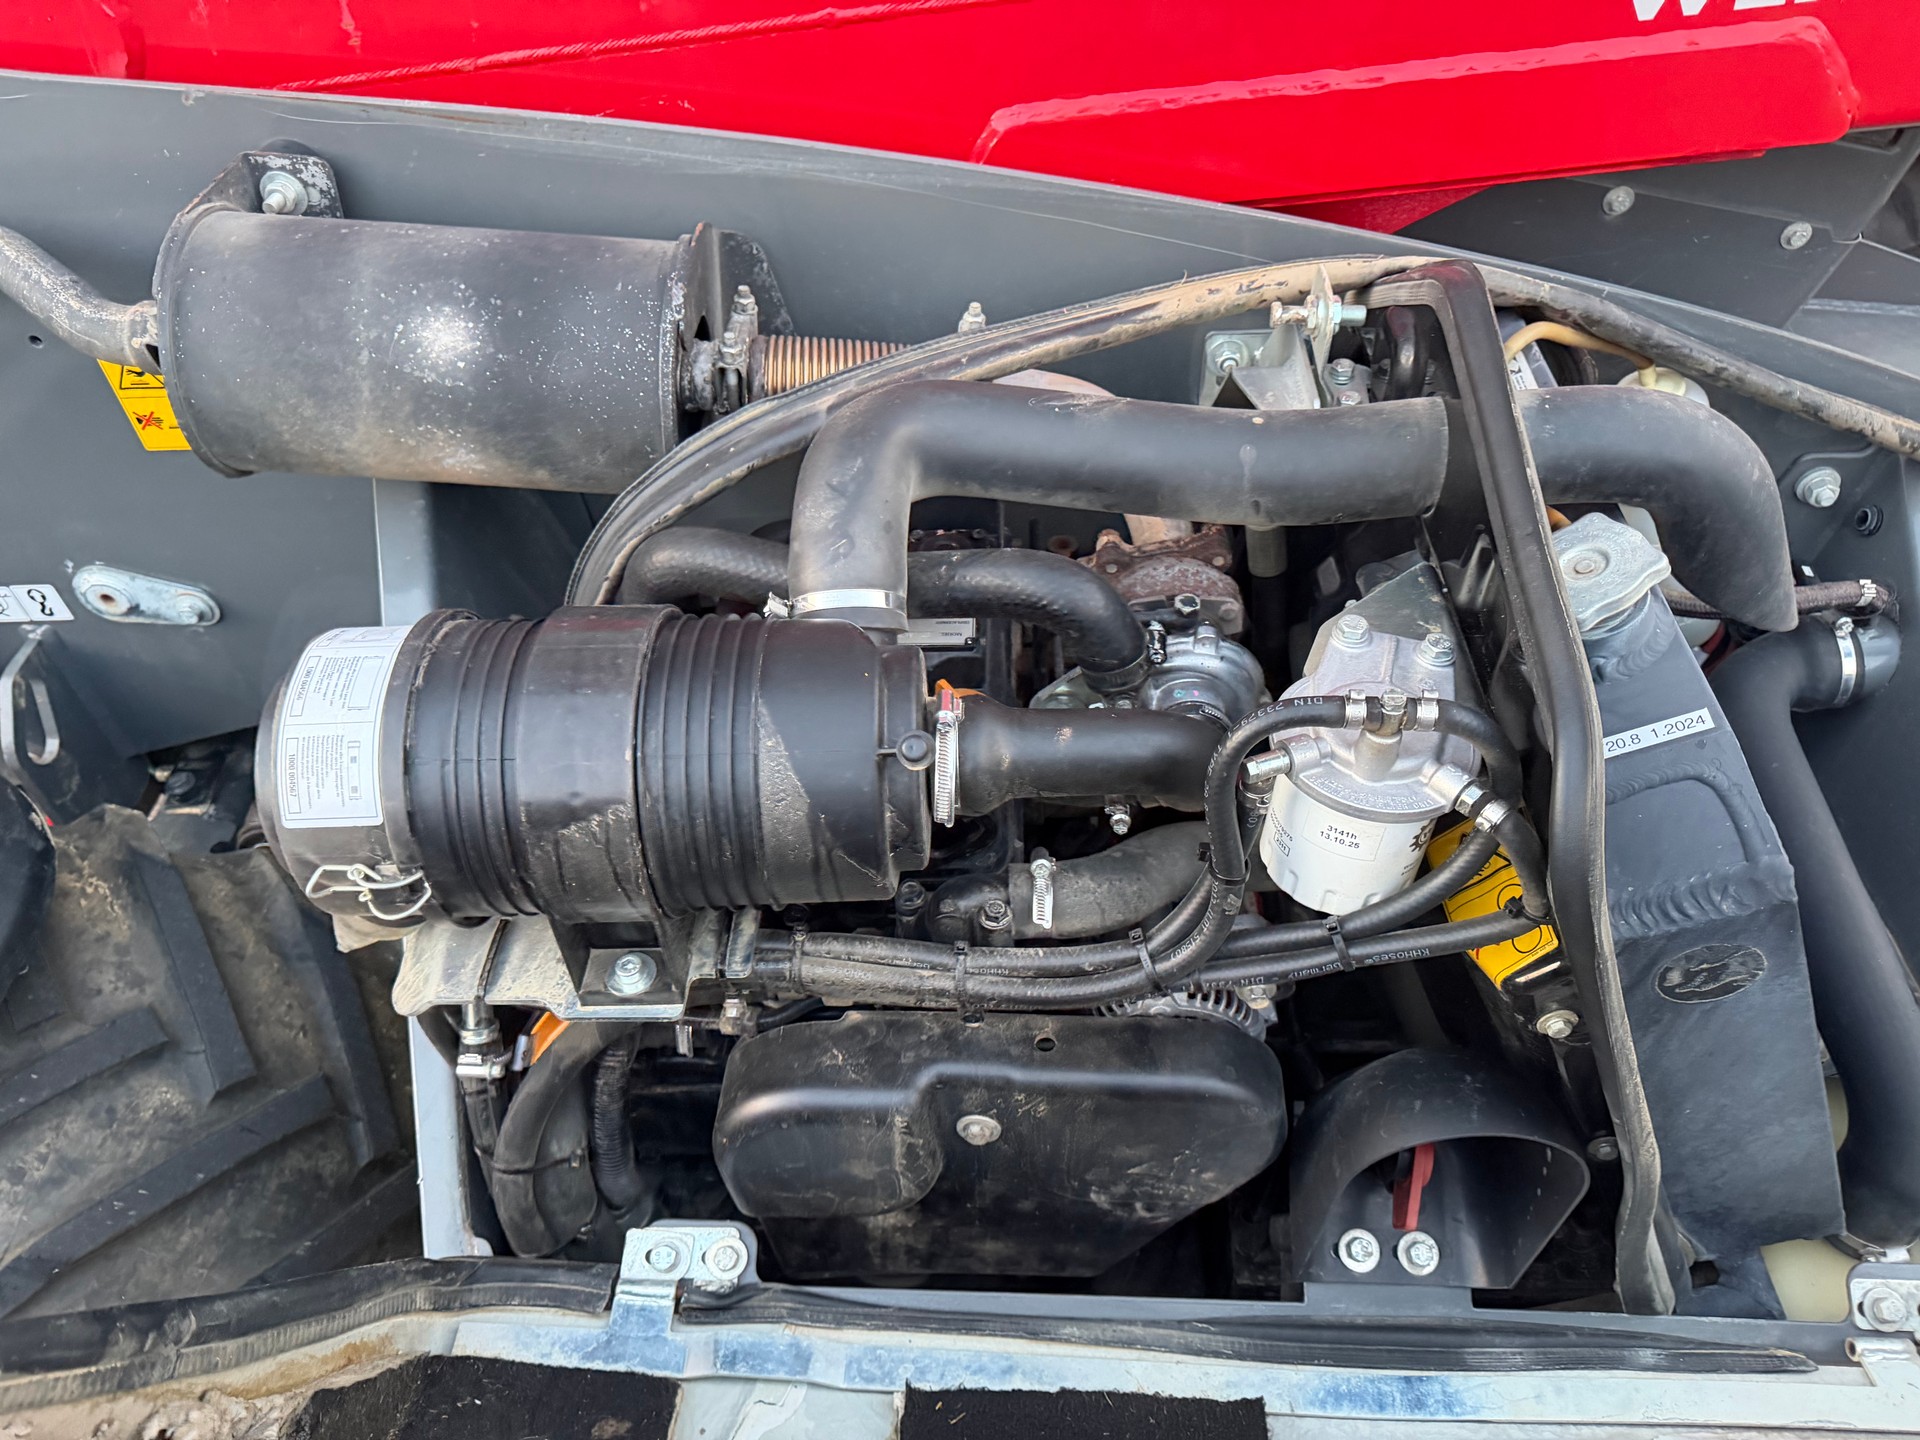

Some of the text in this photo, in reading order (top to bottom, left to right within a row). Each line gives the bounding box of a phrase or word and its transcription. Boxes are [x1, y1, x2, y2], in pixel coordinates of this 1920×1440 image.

[1294, 696, 1323, 706] DIN
[1605, 714, 1707, 752] 20.8 1.2024
[288, 753, 297, 798] 1000 004567
[1319, 830, 1361, 850] 13.10.25
[1327, 824, 1358, 841] 3141h
